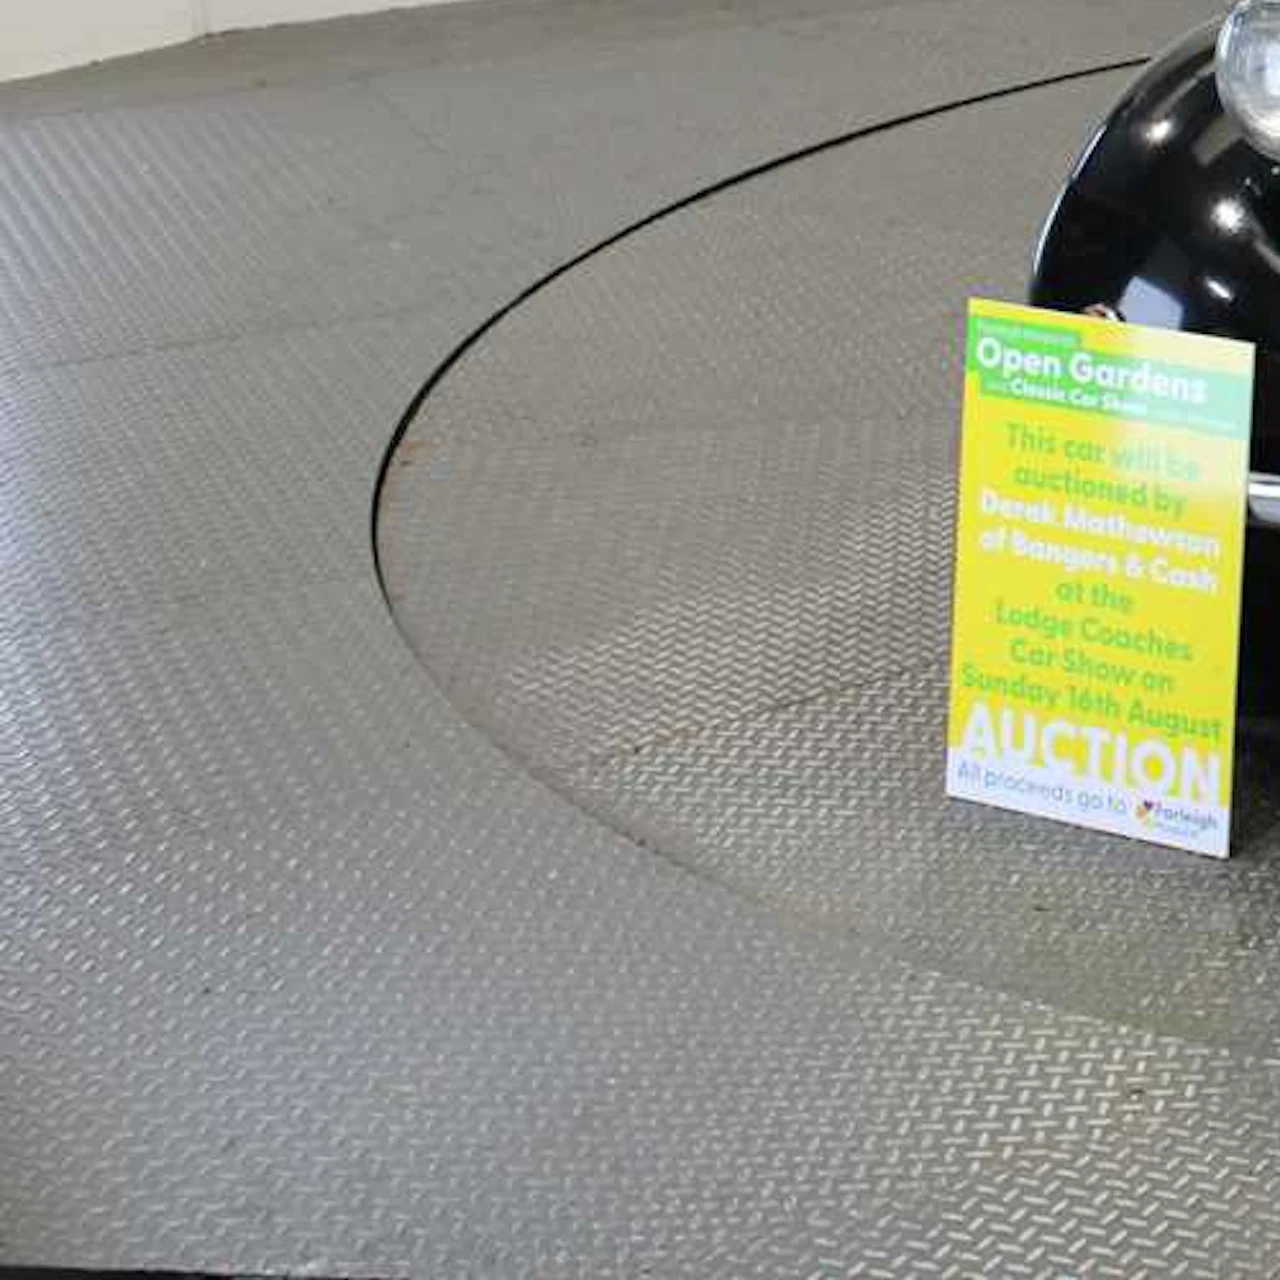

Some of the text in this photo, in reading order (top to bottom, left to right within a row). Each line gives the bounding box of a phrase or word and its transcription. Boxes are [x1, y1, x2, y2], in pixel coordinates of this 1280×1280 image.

[976, 336, 1209, 404] Open Gardens
[1006, 420, 1057, 454] This
[1064, 438, 1106, 463] car
[1111, 442, 1167, 472] will
[1013, 464, 1189, 521] auctioned by
[981, 527, 1005, 552] of
[1011, 531, 1118, 576] Bangers
[1124, 553, 1148, 579] &
[1055, 581, 1133, 613] at the
[996, 597, 1194, 662] Lodge Coaches
[1009, 638, 1175, 694] Car Show on
[962, 662, 1223, 746] Sunday 16th August
[962, 697, 1224, 808] AUCTION
[957, 758, 981, 786] All
[984, 767, 1073, 806] proceeds
[1077, 789, 1104, 813] go
[1153, 800, 1220, 832] Farleigh
